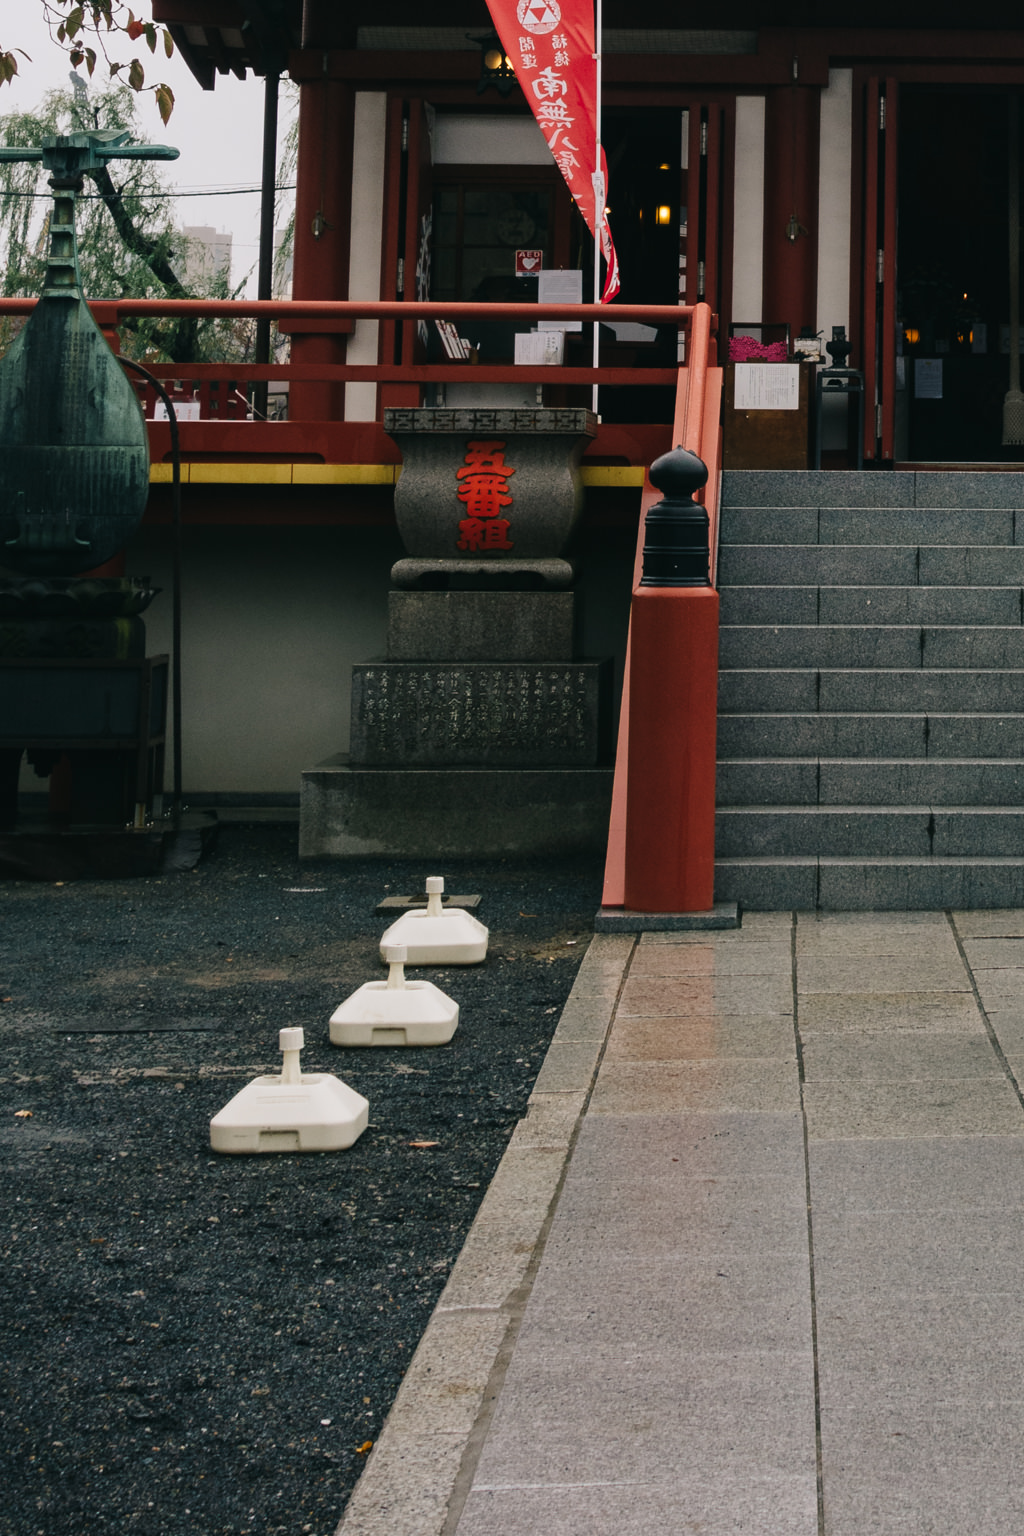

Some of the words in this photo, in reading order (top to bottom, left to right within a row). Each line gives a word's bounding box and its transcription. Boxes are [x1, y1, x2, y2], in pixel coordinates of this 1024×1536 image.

[518, 250, 541, 258] AED
[456, 441, 515, 552] 五番組
